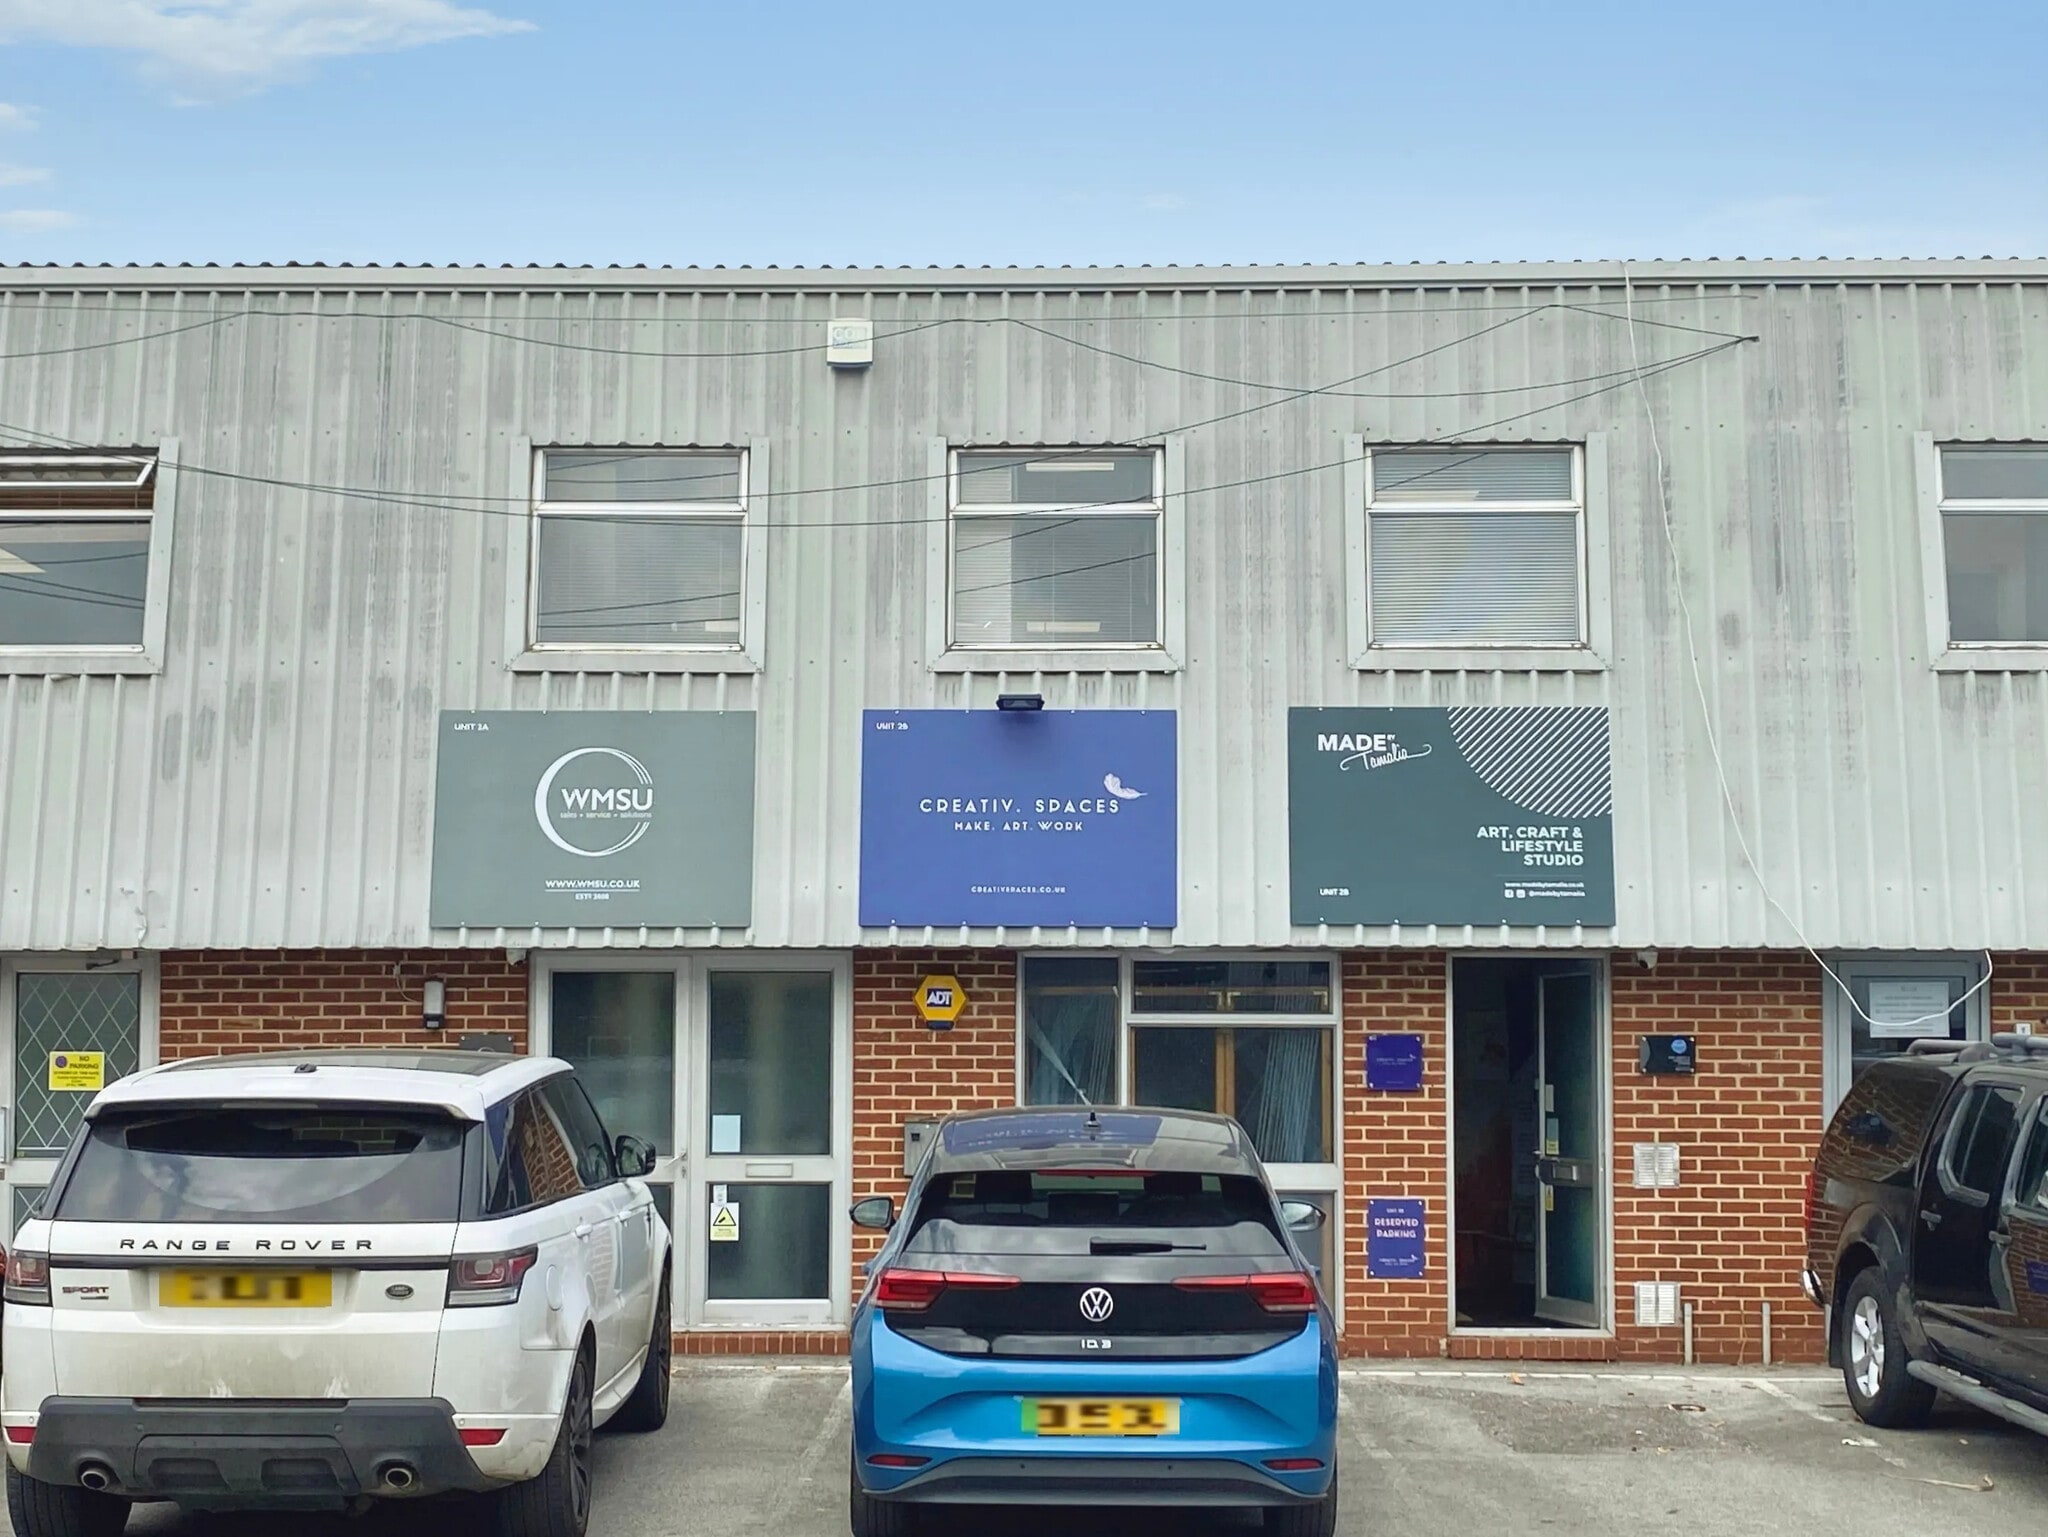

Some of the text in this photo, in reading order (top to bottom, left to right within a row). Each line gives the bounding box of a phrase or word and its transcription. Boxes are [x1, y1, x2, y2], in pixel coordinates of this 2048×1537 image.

[454, 722, 476, 731] UNIT
[876, 722, 895, 731] UNIT
[1317, 733, 1387, 751] MADE
[560, 788, 653, 811] WMSU
[919, 799, 1120, 814] CREATIV. SPACES
[1037, 821, 1083, 832] WORK
[1476, 826, 1583, 839] ART, CRAFT &
[1501, 840, 1584, 852] LIFESTYLE
[1523, 854, 1585, 866] STUDIO
[545, 879, 641, 888] WWW.WMSU.CO.UK
[927, 990, 952, 1005] ADT
[1374, 1217, 1419, 1227] RESERVED
[1376, 1229, 1416, 1238] PARKING
[119, 1238, 372, 1251] RANGE ROVER
[62, 1286, 109, 1294] SPORT
